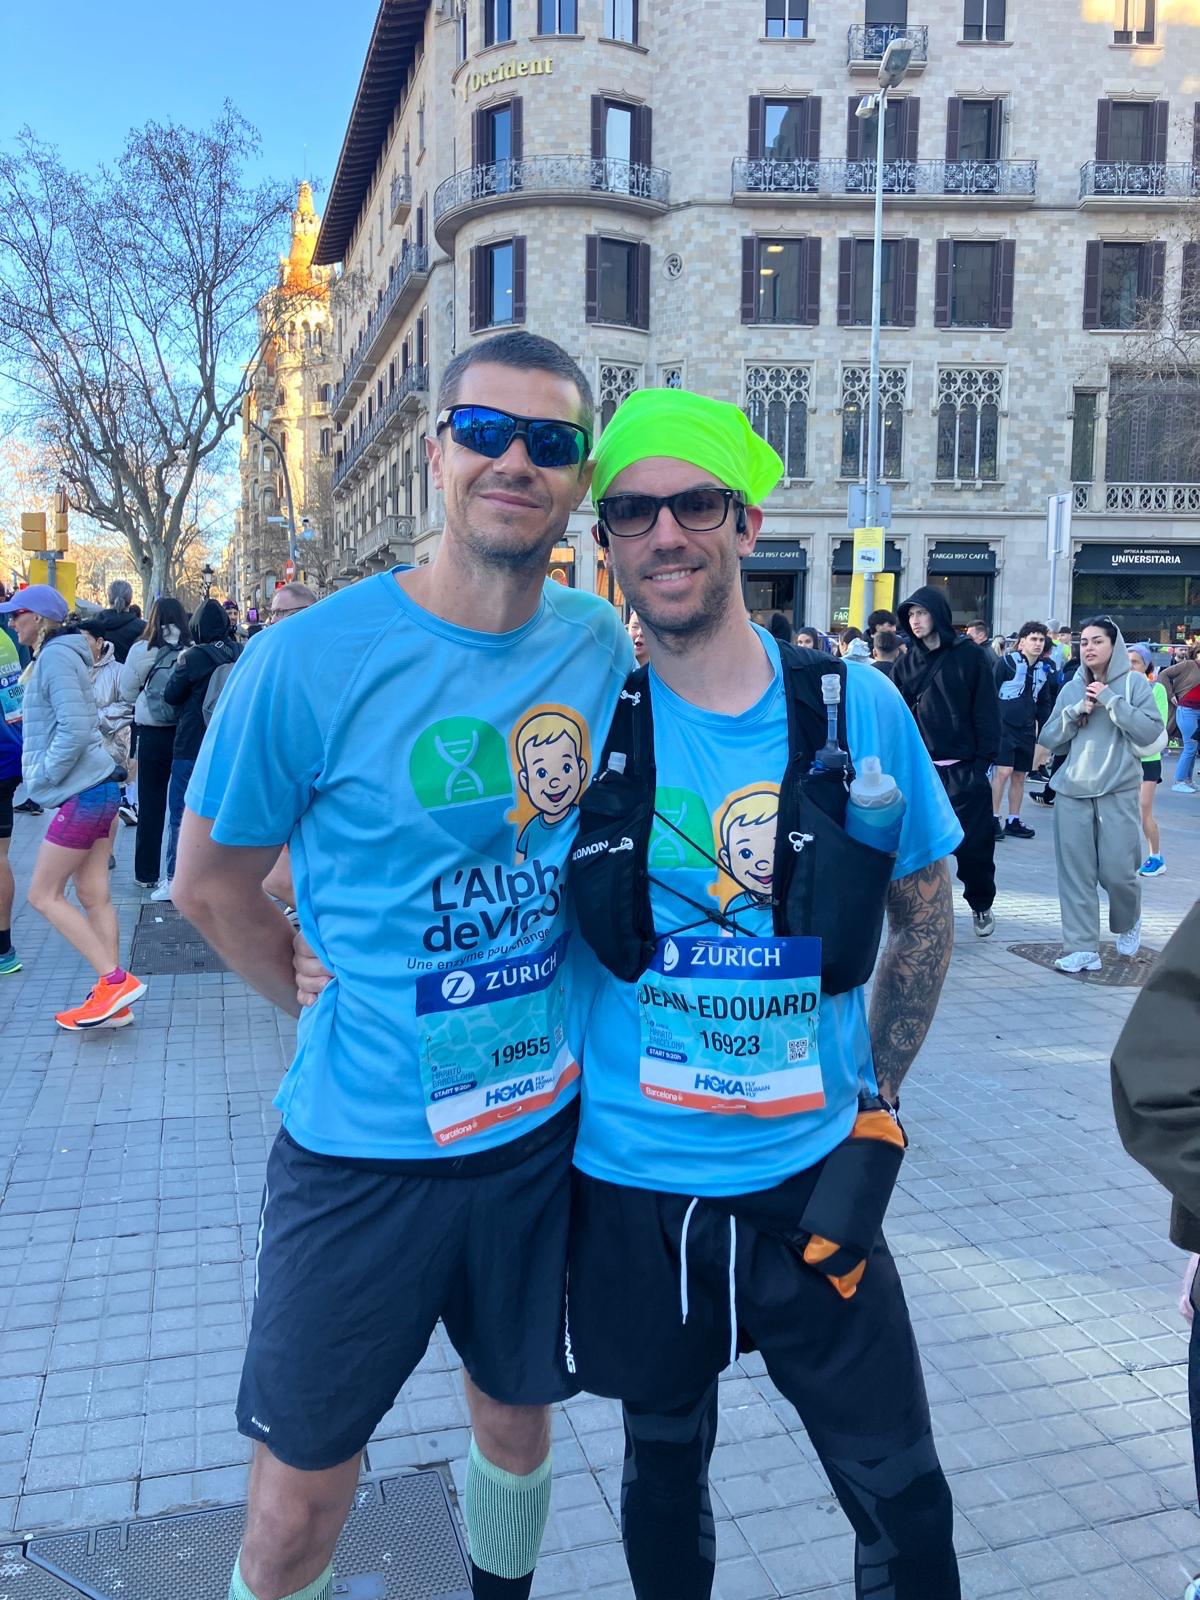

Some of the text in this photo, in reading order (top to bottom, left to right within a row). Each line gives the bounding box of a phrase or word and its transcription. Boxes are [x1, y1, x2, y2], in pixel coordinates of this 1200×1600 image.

[470, 56, 553, 92] Occident
[1111, 554, 1181, 565] UNIVERSITARIA
[572, 840, 609, 860] LOMON
[407, 957, 433, 970] Une
[690, 946, 781, 967] ZURICH
[486, 952, 557, 990] ZURICH
[639, 984, 817, 1021] JEAN-EDOUARD
[491, 1036, 550, 1067] 19955
[649, 1049, 665, 1057] START
[700, 1030, 760, 1057] 16923
[434, 1087, 453, 1099] START
[485, 1078, 534, 1107] HOKA
[645, 1088, 678, 1101] Barcelona
[694, 1073, 745, 1096] HOKA
[439, 1124, 472, 1142] Barcelona
